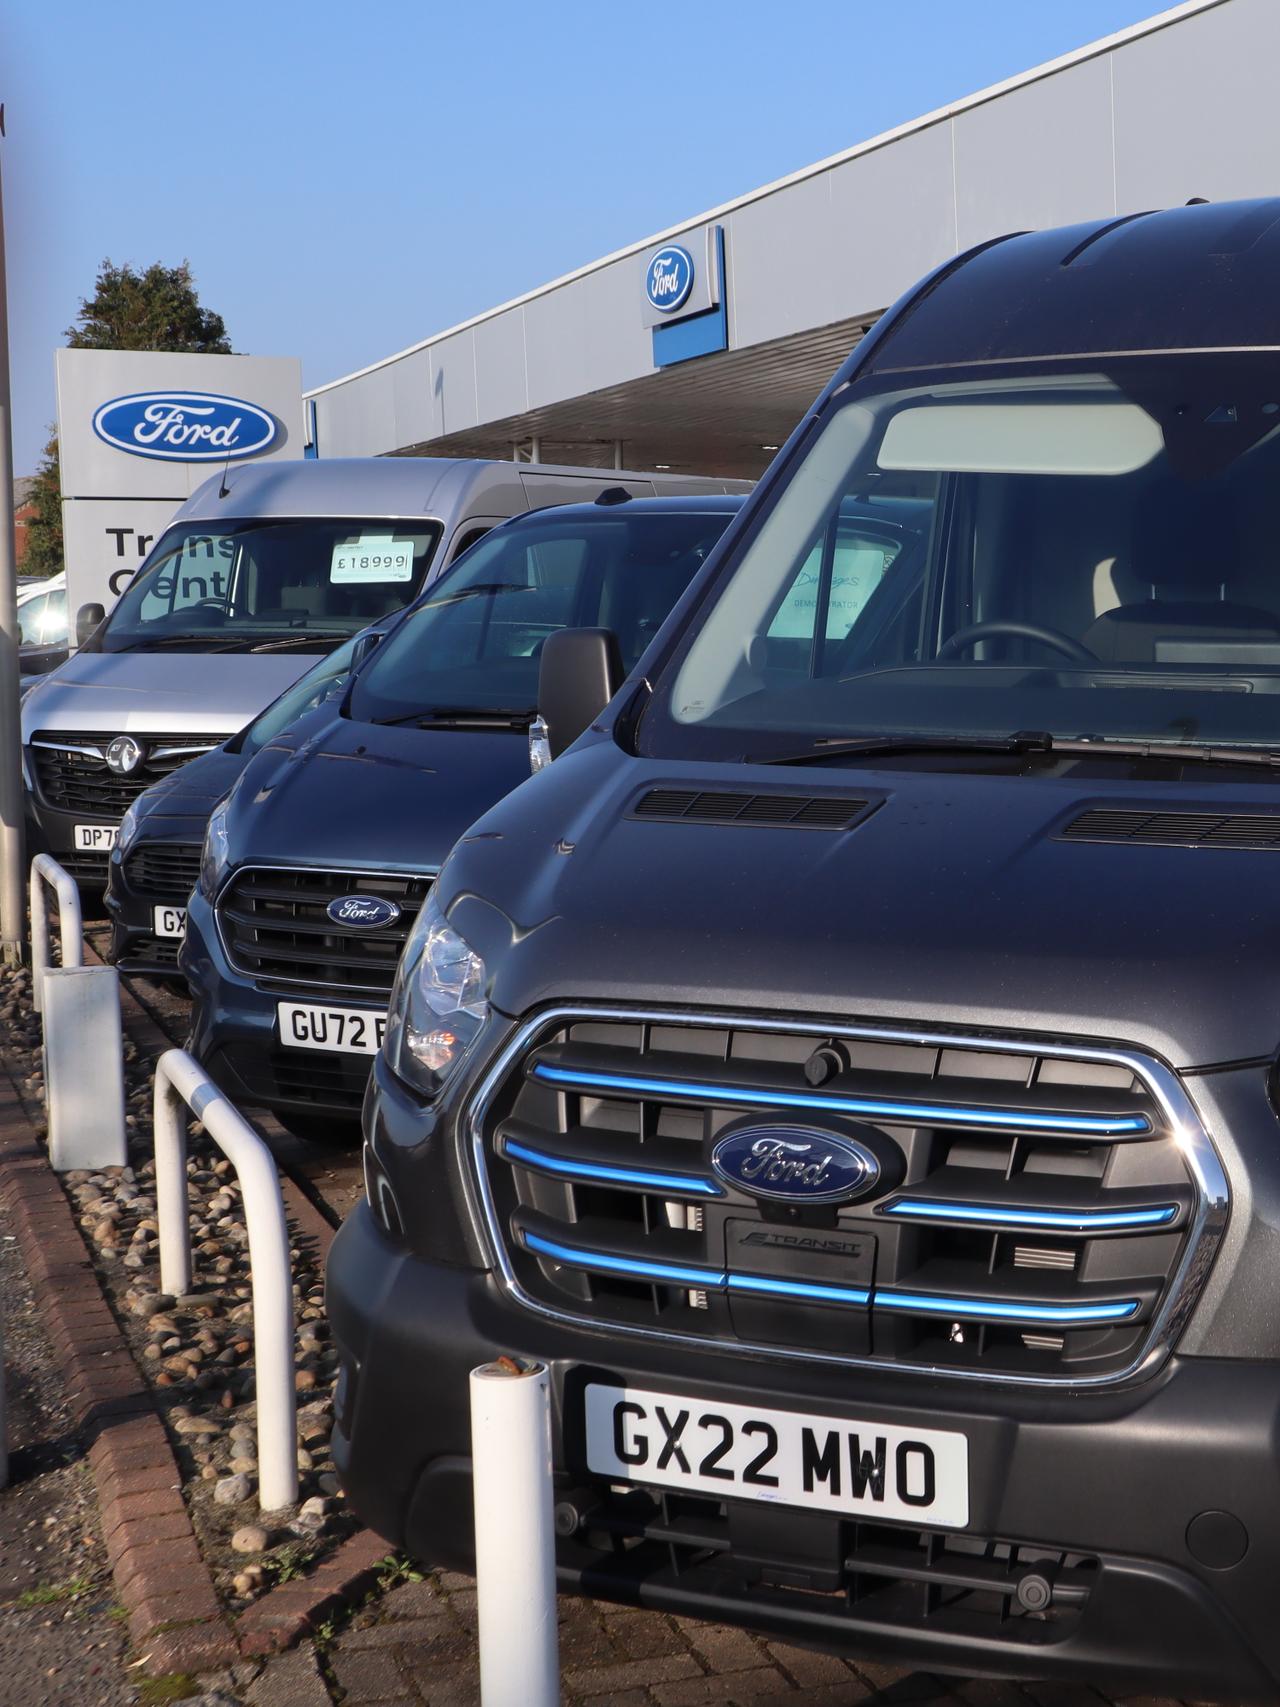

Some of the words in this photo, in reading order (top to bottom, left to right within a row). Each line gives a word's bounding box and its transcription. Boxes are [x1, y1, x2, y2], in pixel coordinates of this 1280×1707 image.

[652, 257, 679, 298] Ford
[134, 403, 242, 446] Ford
[105, 527, 234, 559] Trns
[339, 900, 380, 919] Ford
[291, 1010, 367, 1047] GU72
[741, 1138, 833, 1186] Ford
[612, 1401, 779, 1487] GX22
[801, 1427, 935, 1507] MWO
